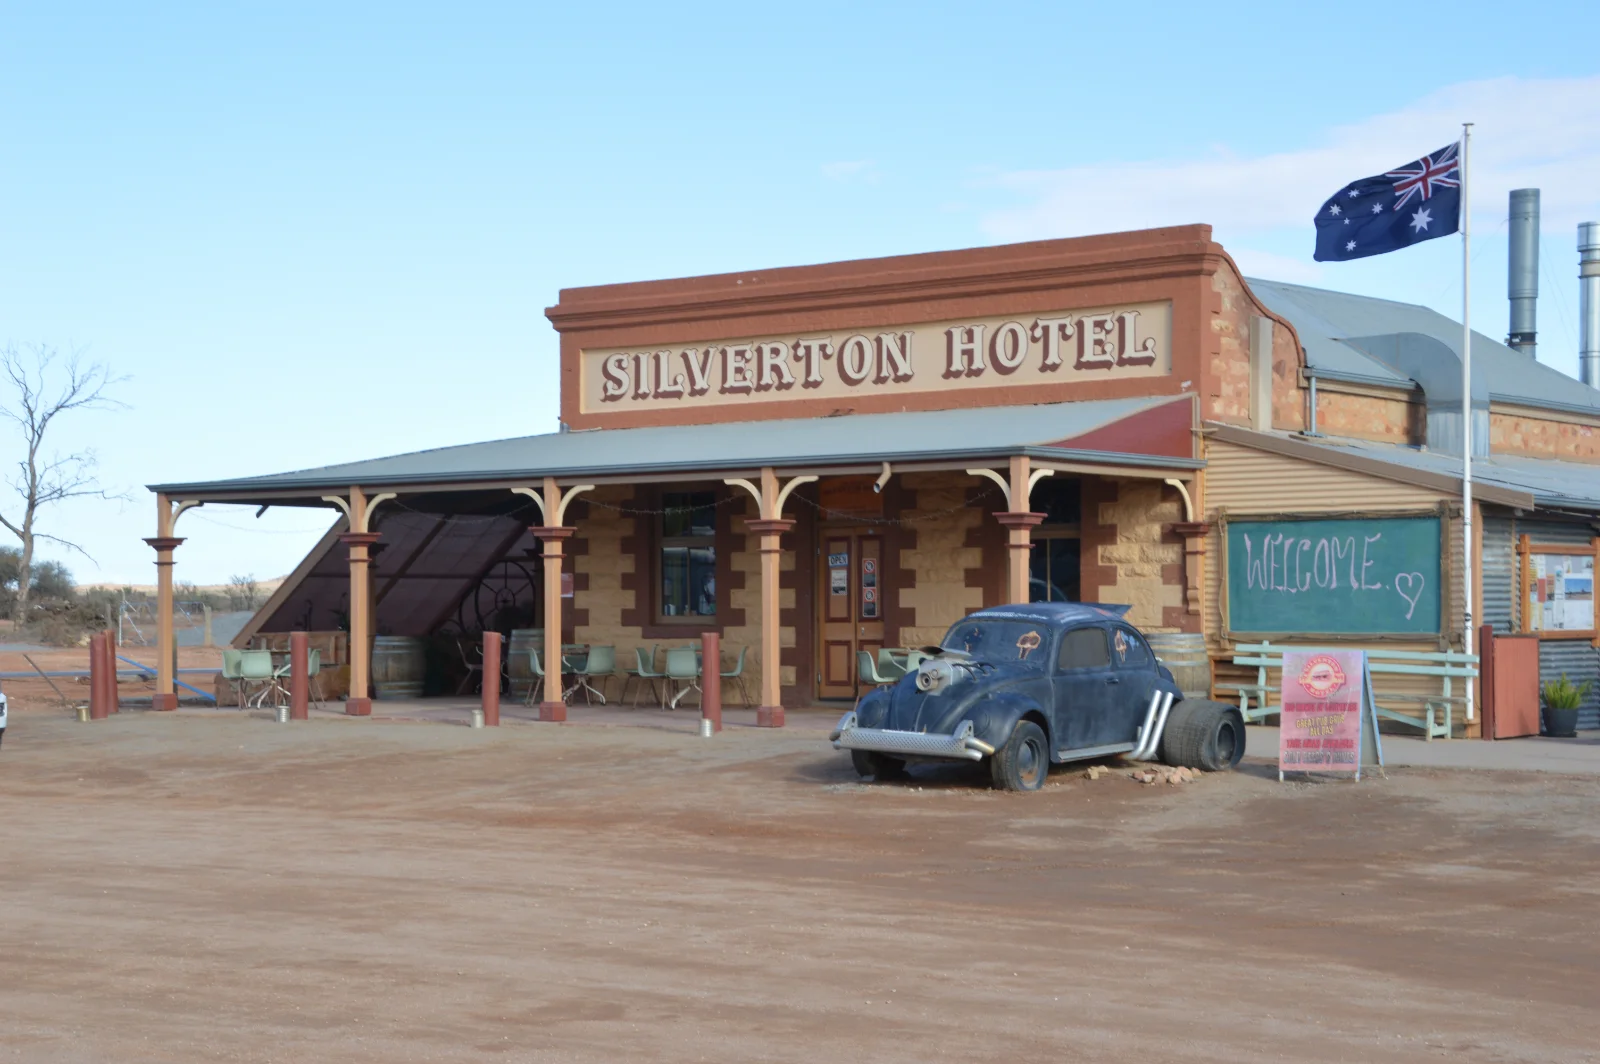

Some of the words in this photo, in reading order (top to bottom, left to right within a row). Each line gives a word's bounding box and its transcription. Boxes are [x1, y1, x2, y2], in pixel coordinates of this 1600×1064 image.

[600, 330, 915, 402] SILVERTON
[942, 310, 1157, 379] HOTEL
[831, 555, 847, 565] OPEN
